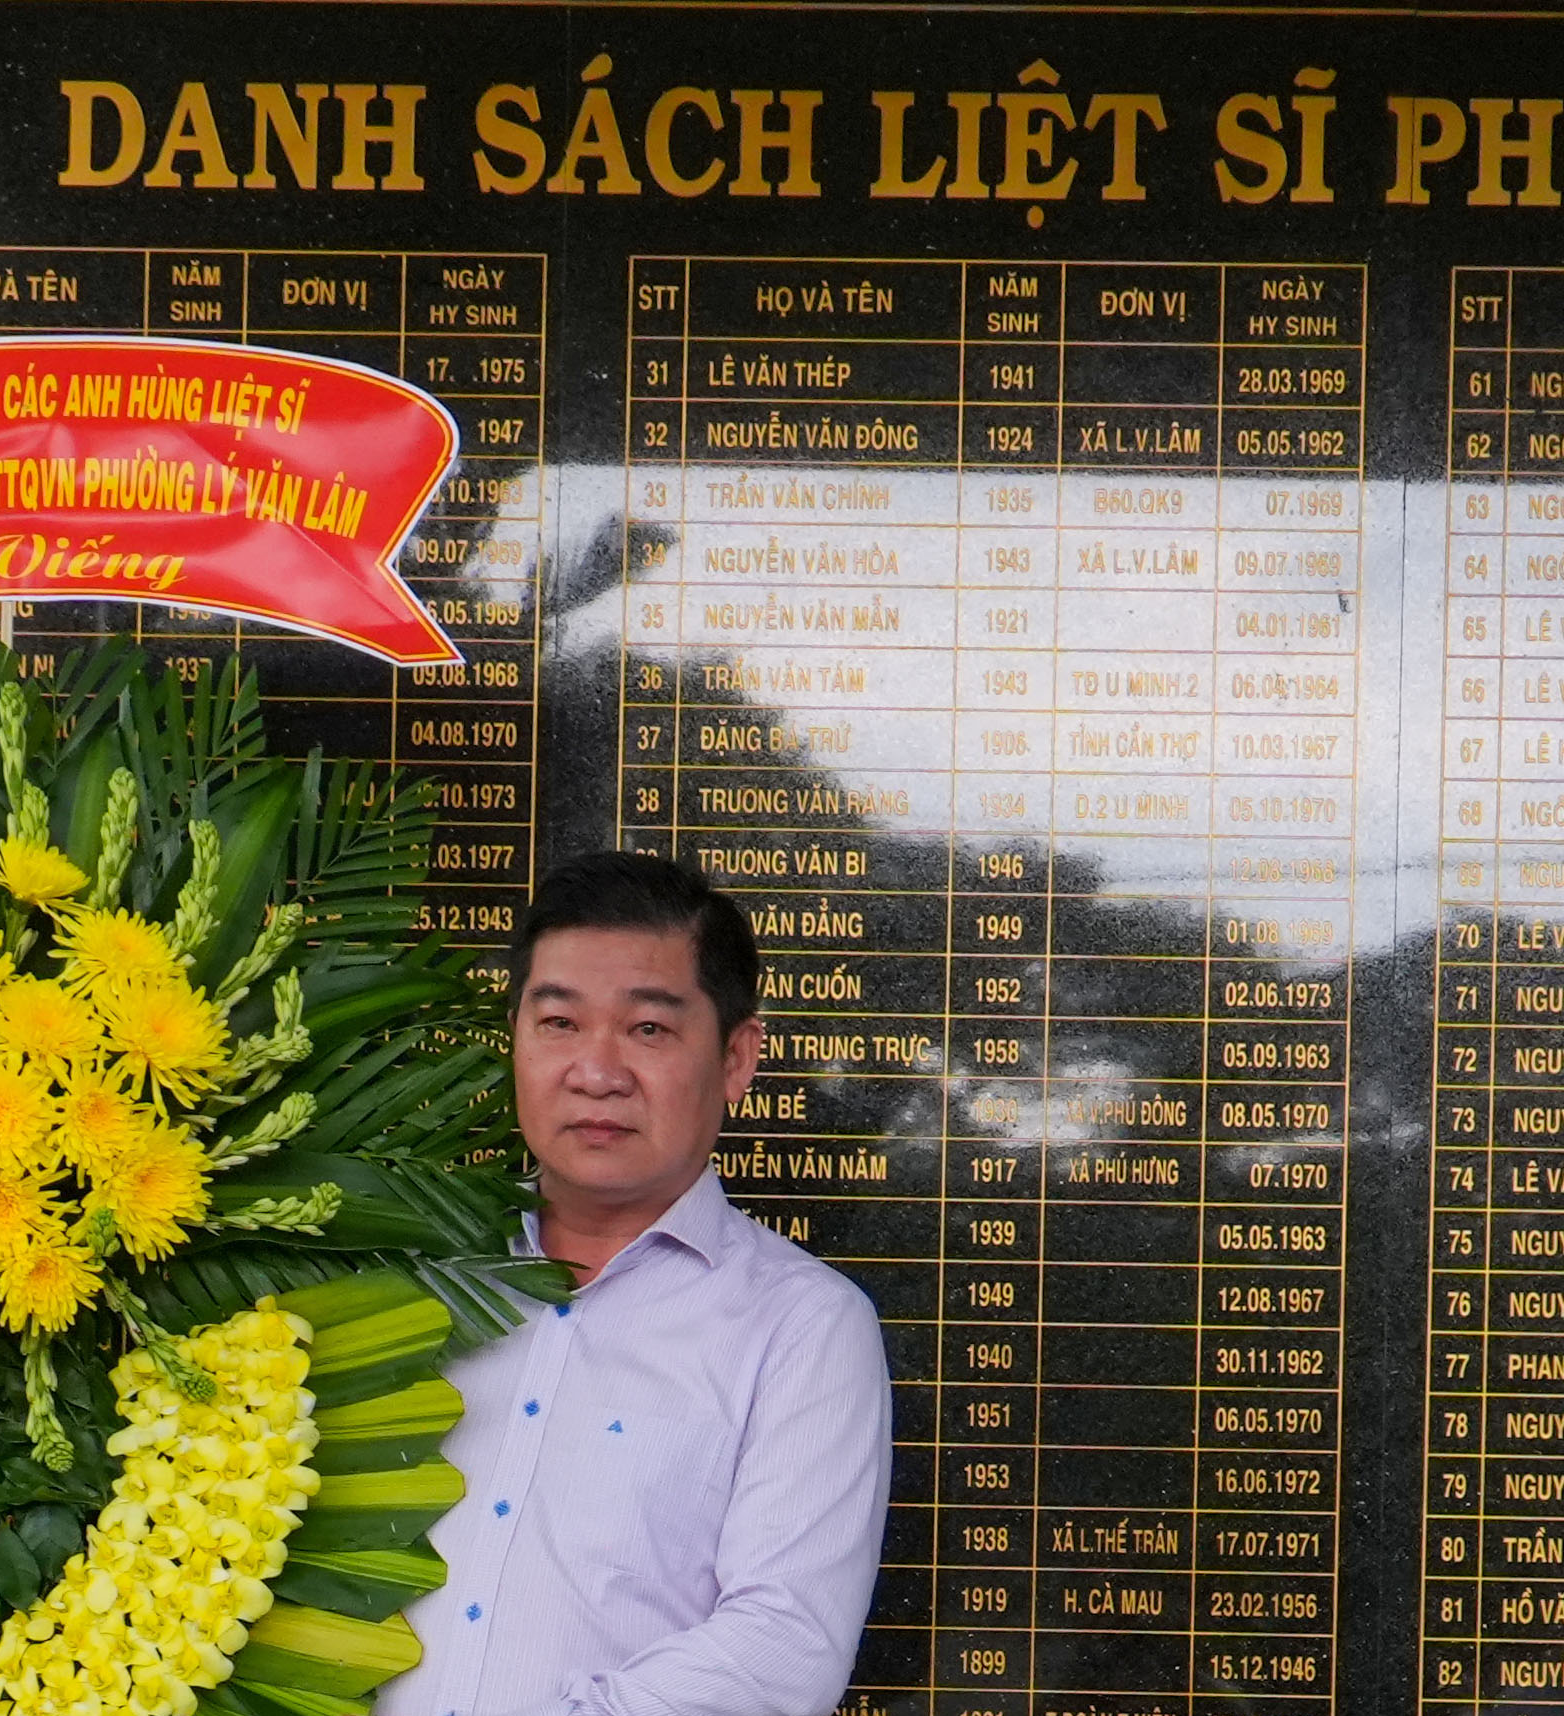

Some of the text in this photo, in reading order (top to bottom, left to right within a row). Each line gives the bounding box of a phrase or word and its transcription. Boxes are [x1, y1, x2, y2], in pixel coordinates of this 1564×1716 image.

[57, 80, 426, 191] DANH
[472, 53, 823, 198] SÁCH
[870, 59, 1168, 229] LIỆT
[1214, 67, 1336, 205] SĨ
[26, 268, 78, 303] TÊN
[171, 260, 222, 287] NĂM
[442, 264, 505, 291] NGÀY
[989, 272, 1039, 298] NĂM
[282, 276, 368, 311] ĐƠN VỊ
[638, 284, 680, 311] STT
[756, 280, 894, 318] HỌ VÀ TÊN
[1261, 275, 1324, 302] NGÀY
[169, 300, 223, 323] SINH
[429, 304, 518, 326] HY SINH
[1100, 287, 1186, 323] ĐƠN VỊ
[1461, 295, 1503, 323] STT
[987, 312, 1040, 334] SINH
[1248, 315, 1338, 338] HY SINH
[647, 360, 669, 387] 31
[708, 353, 852, 389] LÊ VĂN THÉP
[989, 364, 1035, 390] 1941
[1238, 367, 1347, 395] 28.03.1969
[1468, 371, 1492, 398] 61
[3, 363, 58, 419] CÁC
[64, 374, 121, 417] ANH
[128, 364, 203, 422] HÙNG
[209, 373, 273, 440] LIỆT
[276, 378, 310, 433] SĨ
[478, 418, 524, 444] 1947
[644, 421, 669, 447] 32
[707, 410, 799, 449] NGUYỄN
[804, 417, 850, 449] VĂN
[987, 426, 1034, 453] 1924
[1079, 420, 1202, 454] XÃ L.V.LÂM
[1236, 429, 1345, 457] 05.05.1962
[83, 444, 195, 513] PHƯỜNG
[201, 452, 239, 515] LÝ
[246, 460, 302, 524] VĂN
[303, 473, 368, 539] LÂM
[411, 720, 518, 748] 04.08.1970
[790, 1033, 934, 1068] TRUNG TRỰC
[973, 1038, 1020, 1065] 1958
[1222, 1042, 1331, 1070] 05.09.1963
[1445, 1353, 1470, 1379] 77
[963, 1526, 1009, 1552] 1938
[1052, 1521, 1075, 1552] XÃ
[1216, 1531, 1320, 1558] 17.07.1971
